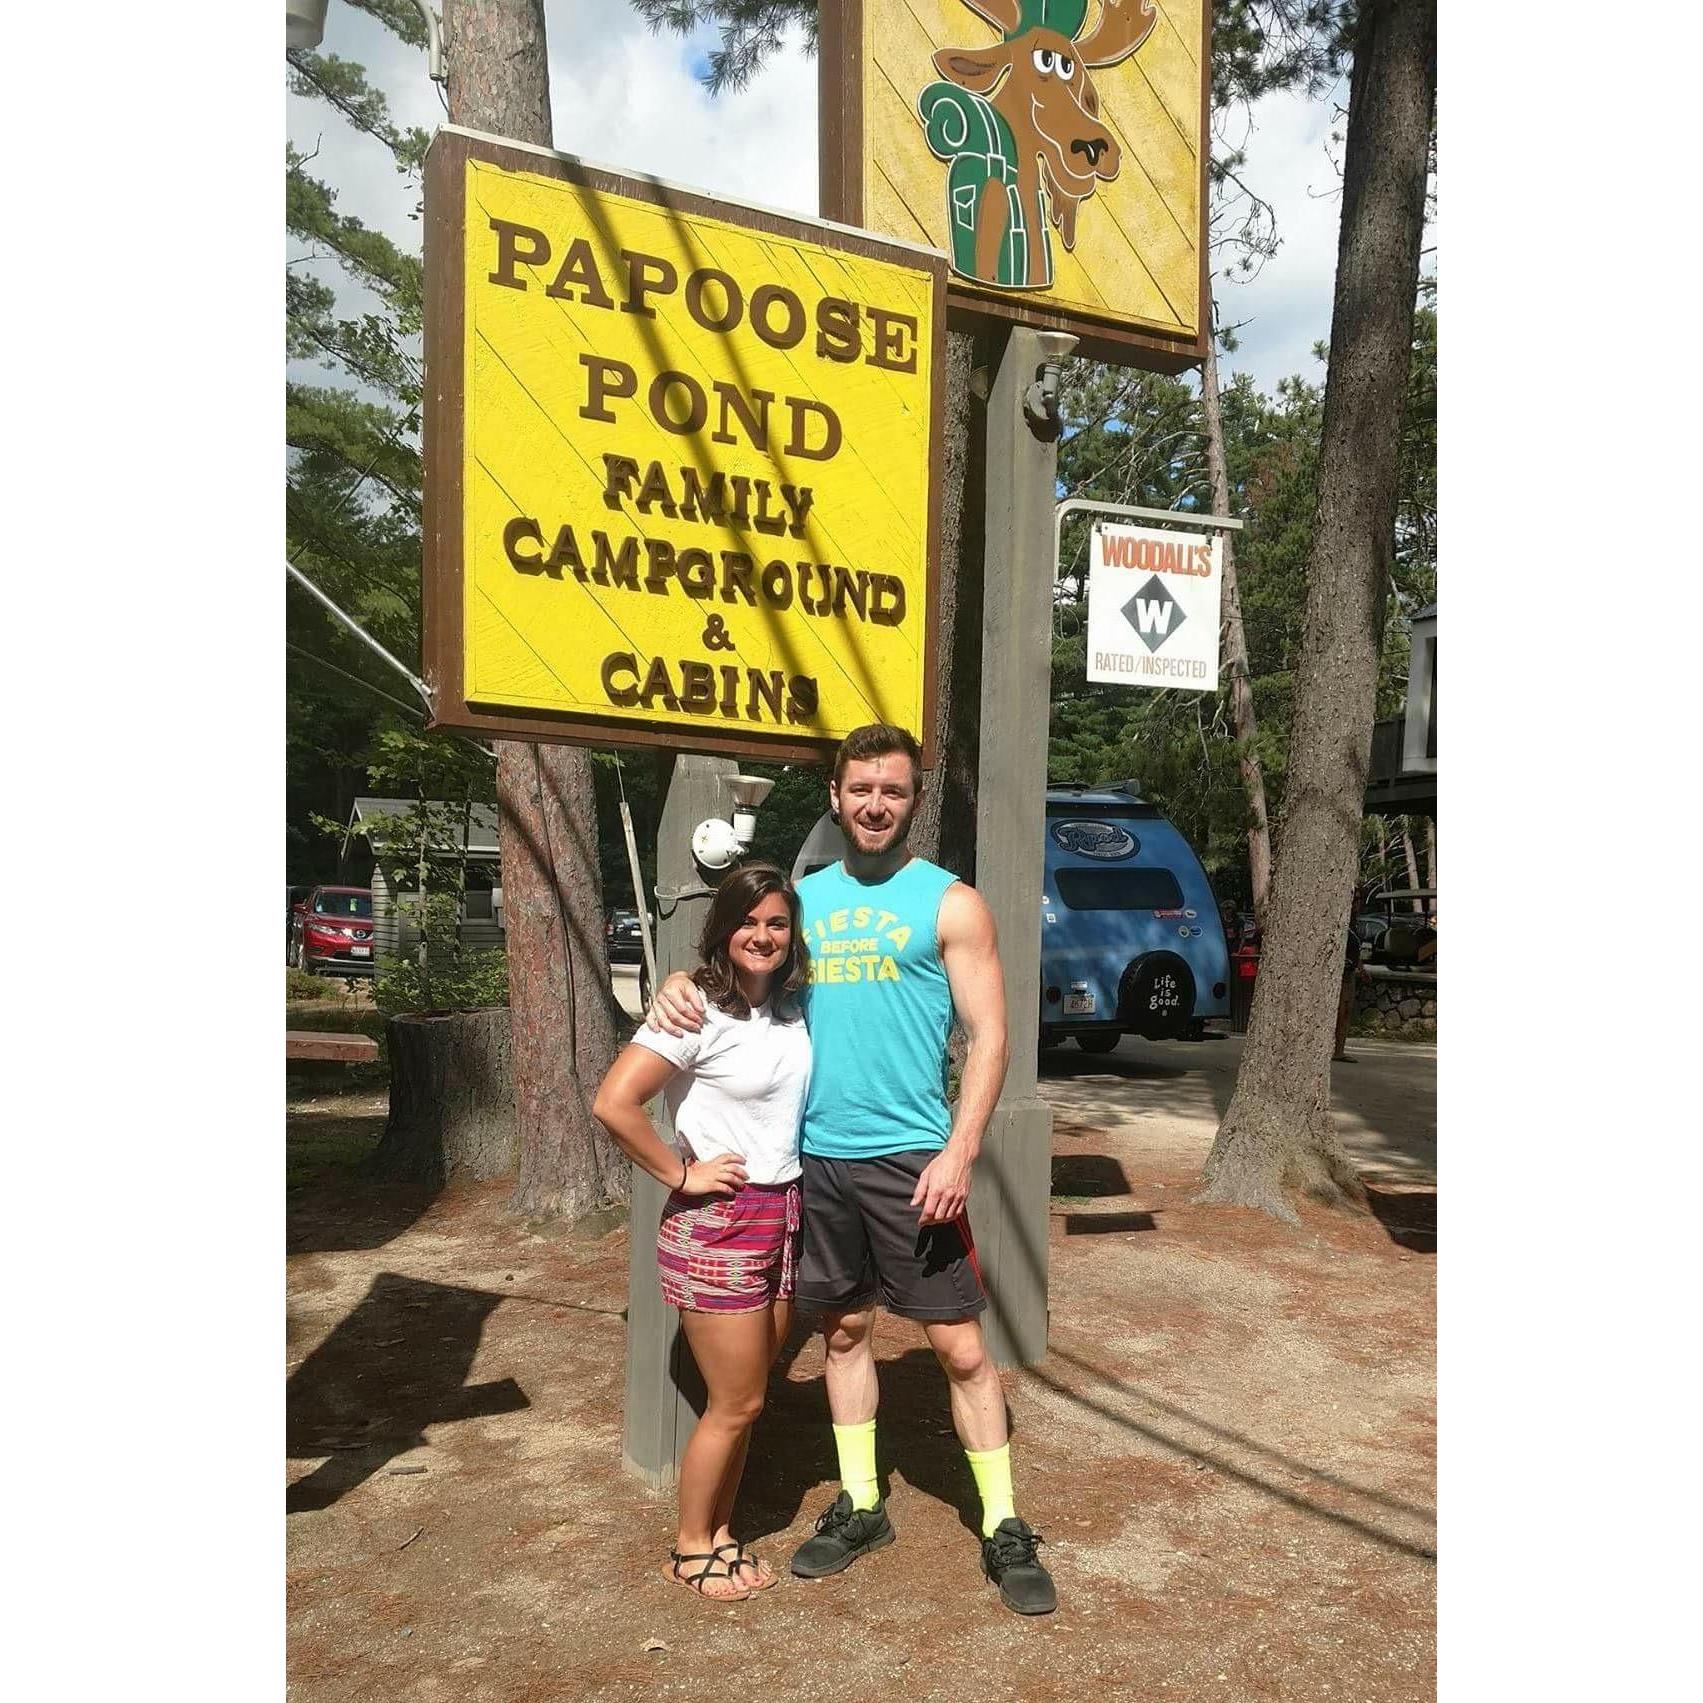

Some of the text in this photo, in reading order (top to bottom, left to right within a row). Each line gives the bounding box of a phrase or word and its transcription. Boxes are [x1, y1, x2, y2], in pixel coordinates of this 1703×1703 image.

[488, 217, 918, 374] PAPOOSE
[578, 353, 842, 462] POND
[602, 453, 814, 539] FAMILY
[502, 518, 906, 626] CAMPGROUND
[1102, 534, 1212, 578] WOODALL'S
[702, 614, 735, 650] &
[1136, 598, 1173, 634] W
[1095, 651, 1207, 679] RATED/INSPECTED
[601, 652, 819, 725] CABINS
[821, 938, 878, 954] BEFORE
[1154, 974, 1176, 989] Life
[1160, 988, 1171, 997] is
